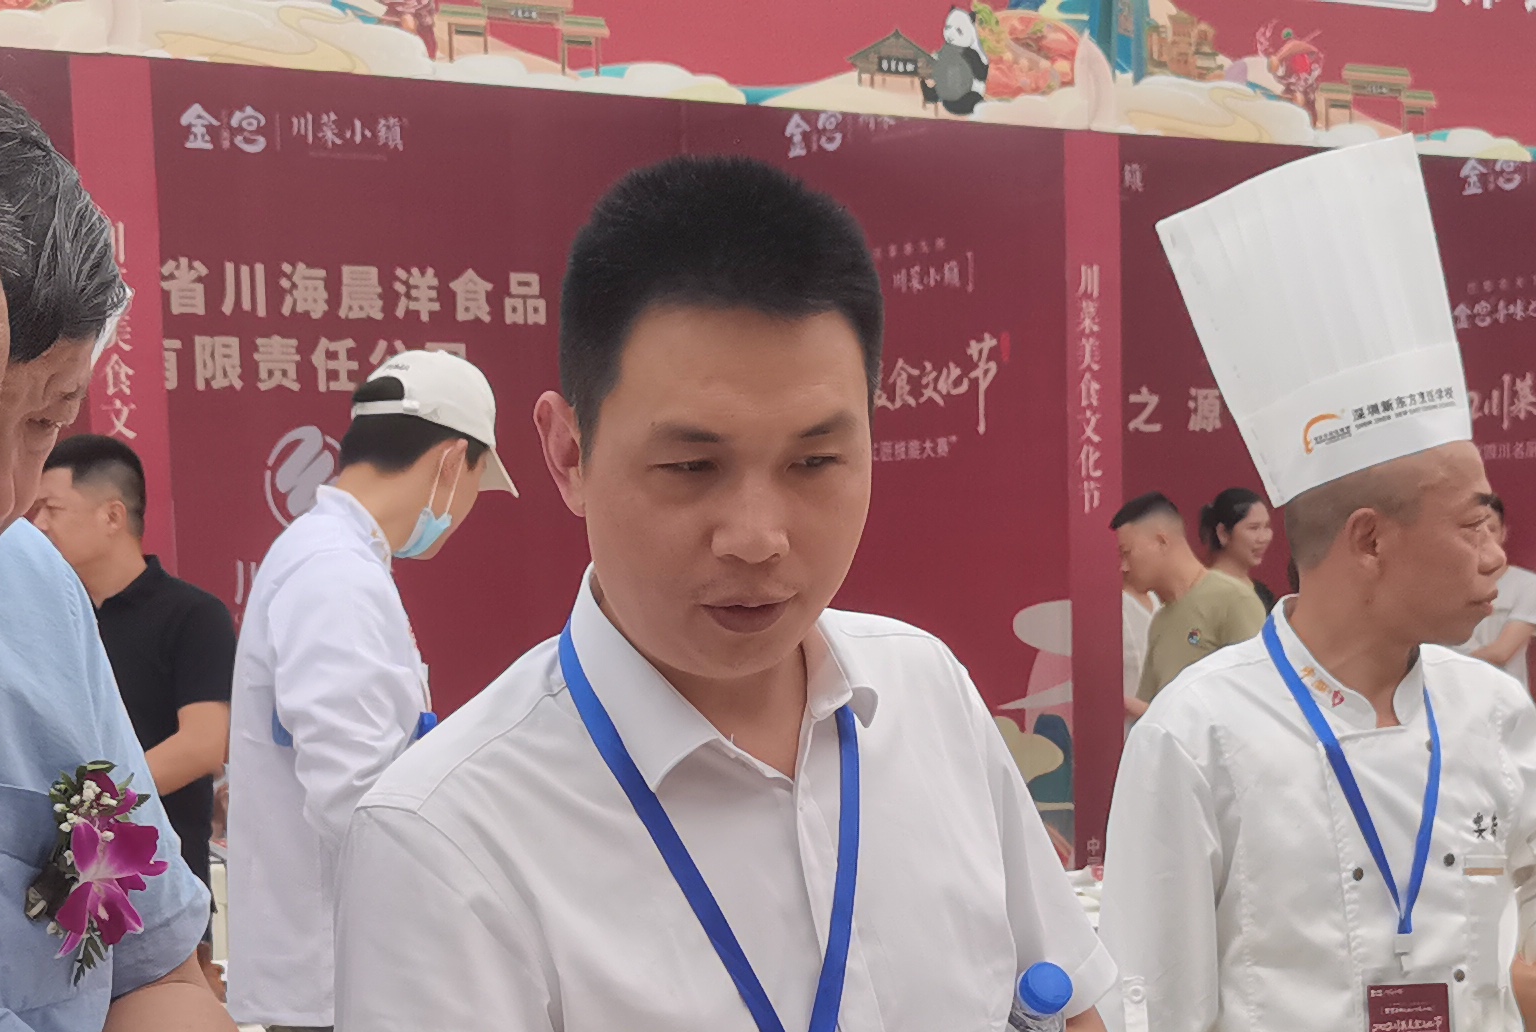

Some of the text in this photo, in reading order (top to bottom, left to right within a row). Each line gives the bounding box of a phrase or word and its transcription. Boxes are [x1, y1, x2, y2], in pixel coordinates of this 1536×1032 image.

[160, 256, 547, 326] 省川海晨洋食品
[1075, 264, 1104, 514] 川菜美食文化节
